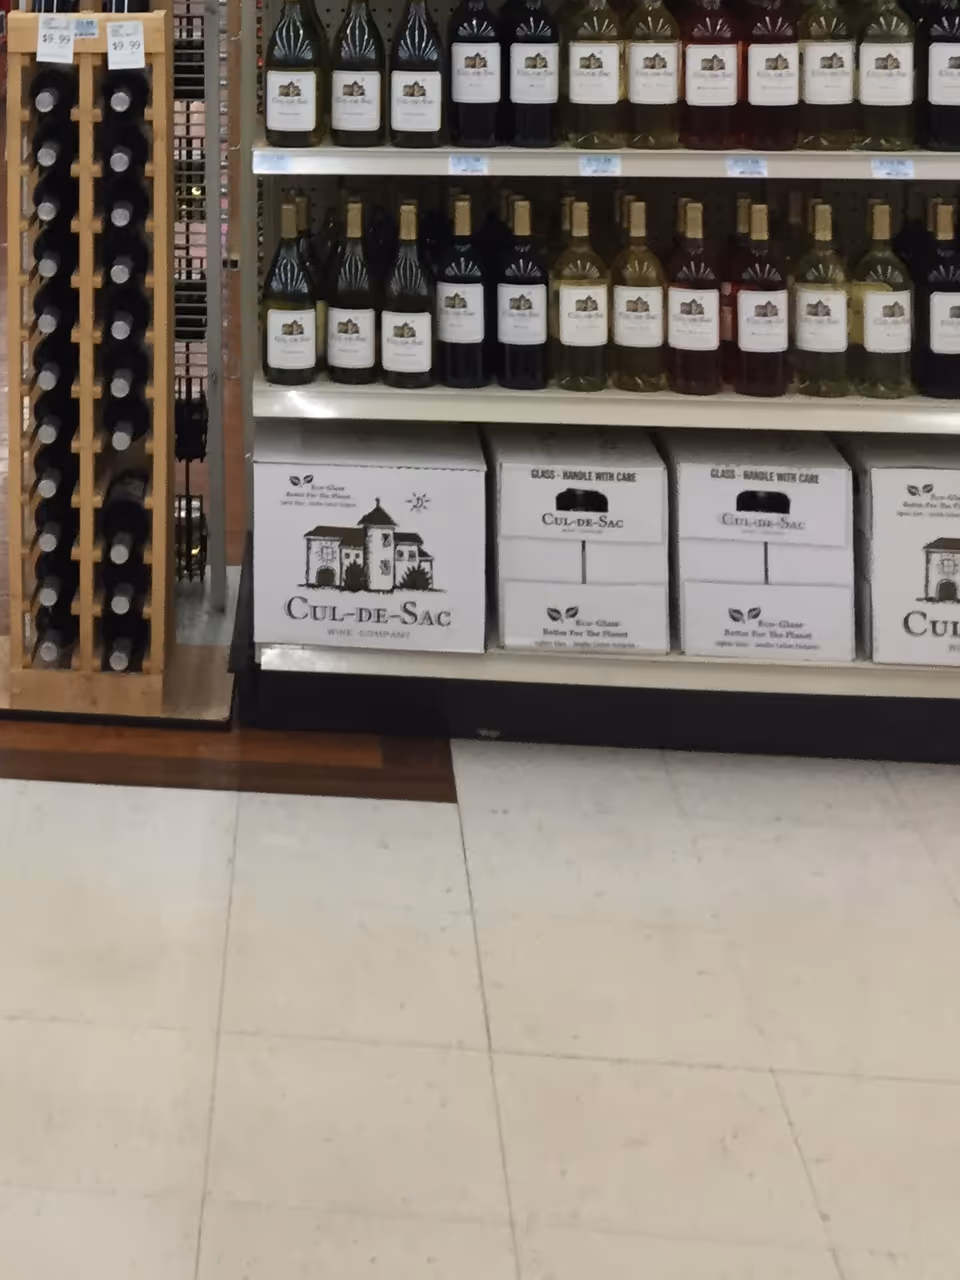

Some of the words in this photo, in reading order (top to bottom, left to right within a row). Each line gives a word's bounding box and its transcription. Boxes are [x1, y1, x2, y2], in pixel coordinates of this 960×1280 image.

[531, 469, 555, 480] GLASS
[563, 471, 593, 481] HANDLE
[595, 471, 615, 482] WITH
[617, 472, 637, 482] CARE
[711, 468, 735, 480] GLASS
[743, 470, 774, 482] HANDLE
[777, 472, 797, 483] WITH
[799, 473, 819, 484] CARE
